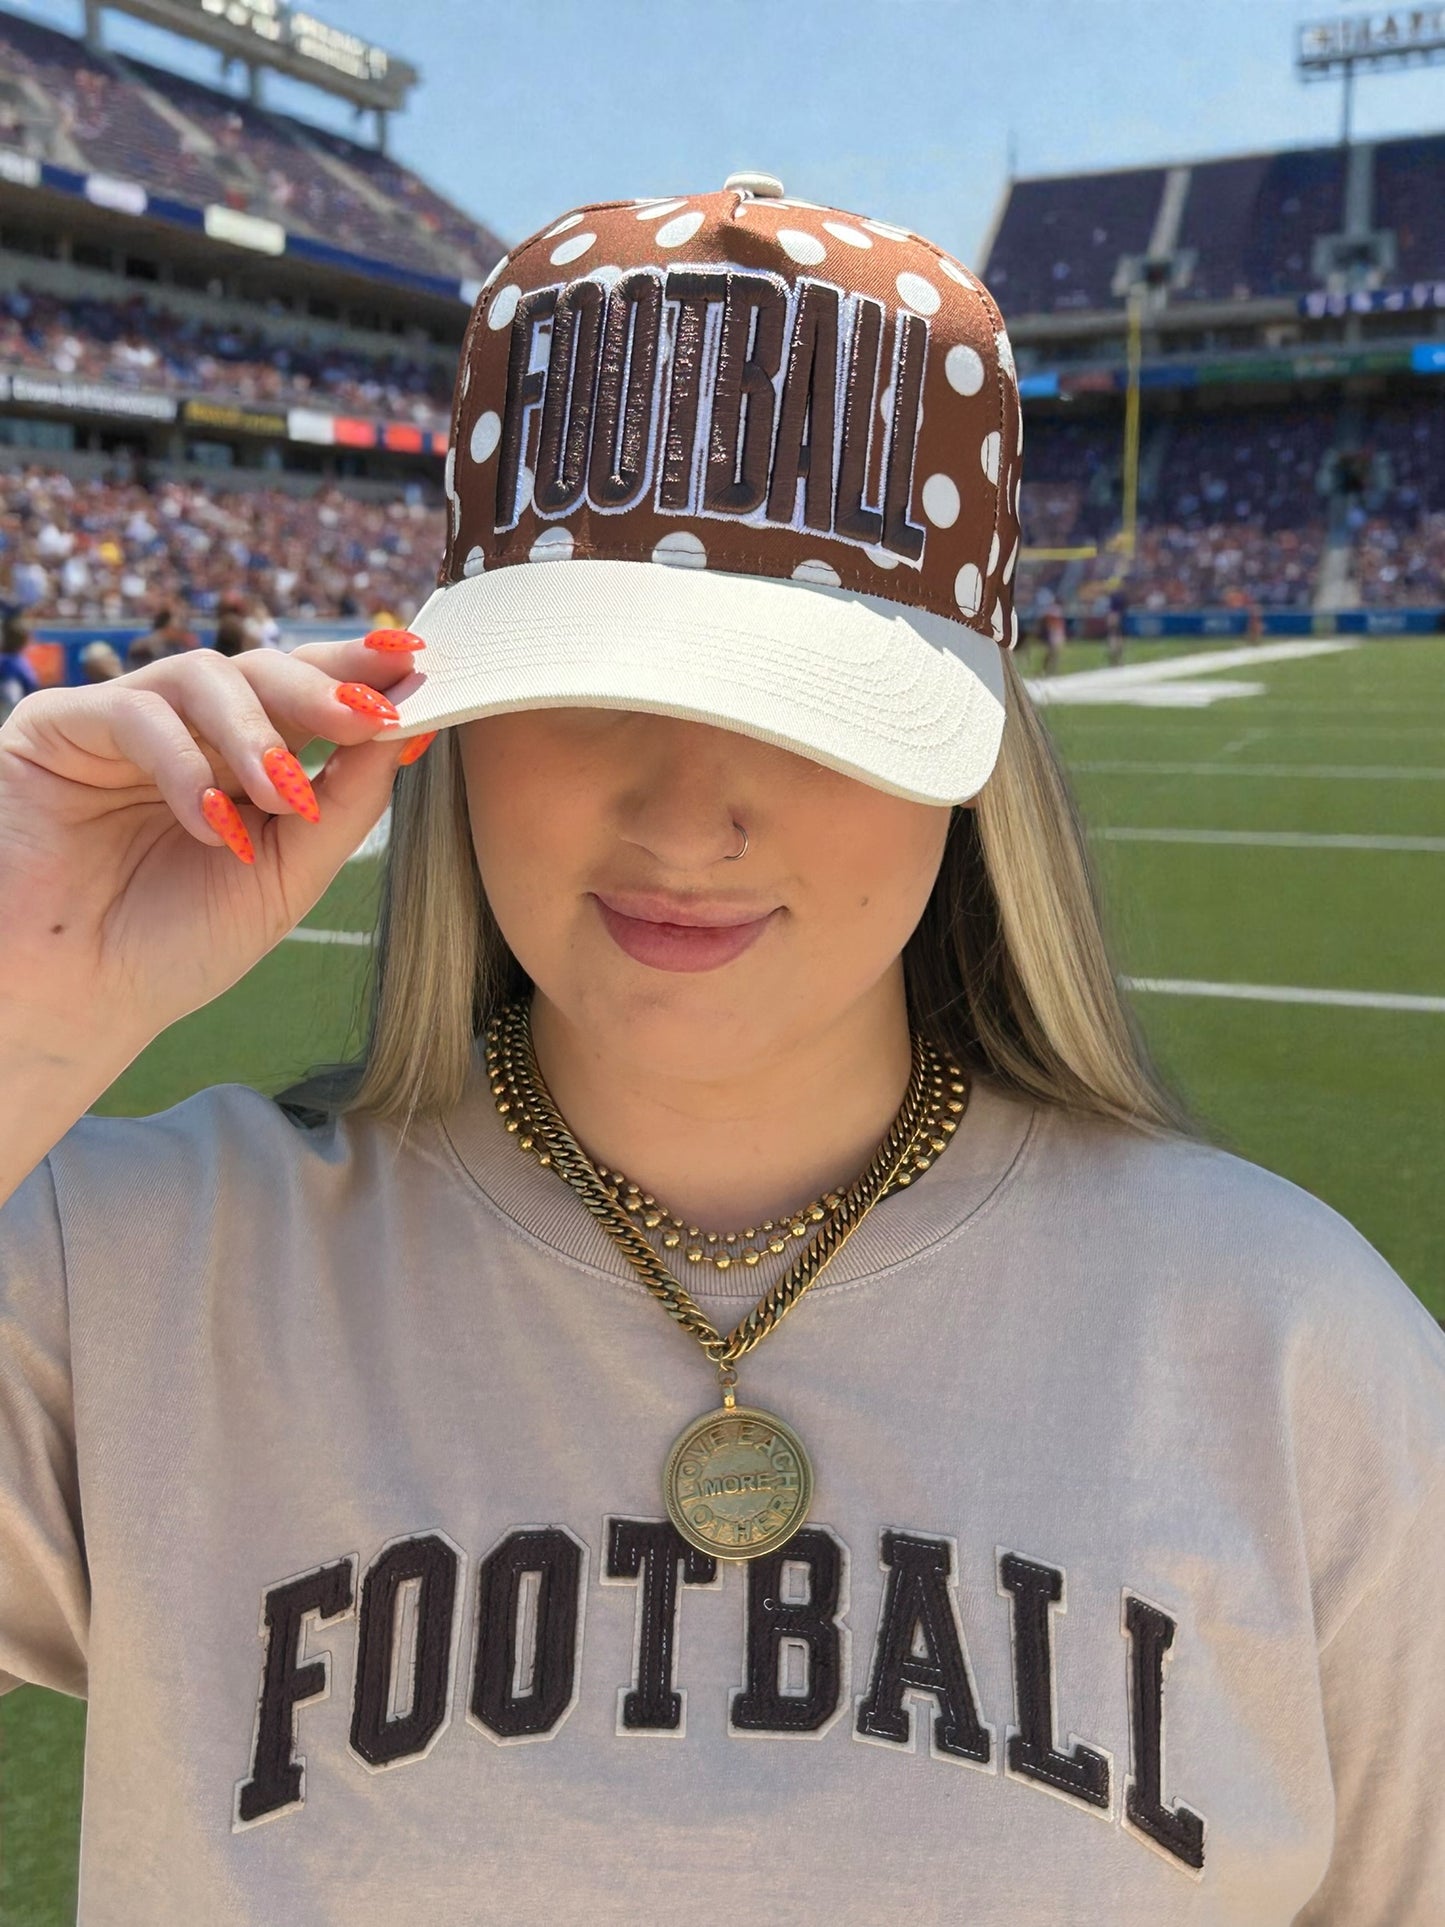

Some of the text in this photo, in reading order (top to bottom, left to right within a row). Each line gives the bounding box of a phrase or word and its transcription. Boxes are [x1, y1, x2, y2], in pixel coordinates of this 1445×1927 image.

[494, 265, 929, 571] FOOTBALL
[681, 1424, 798, 1503] LOVE EACH
[703, 1473, 771, 1496] MORE
[690, 1495, 794, 1542] OTHER
[233, 1515, 1205, 1876] FOOTBALL
